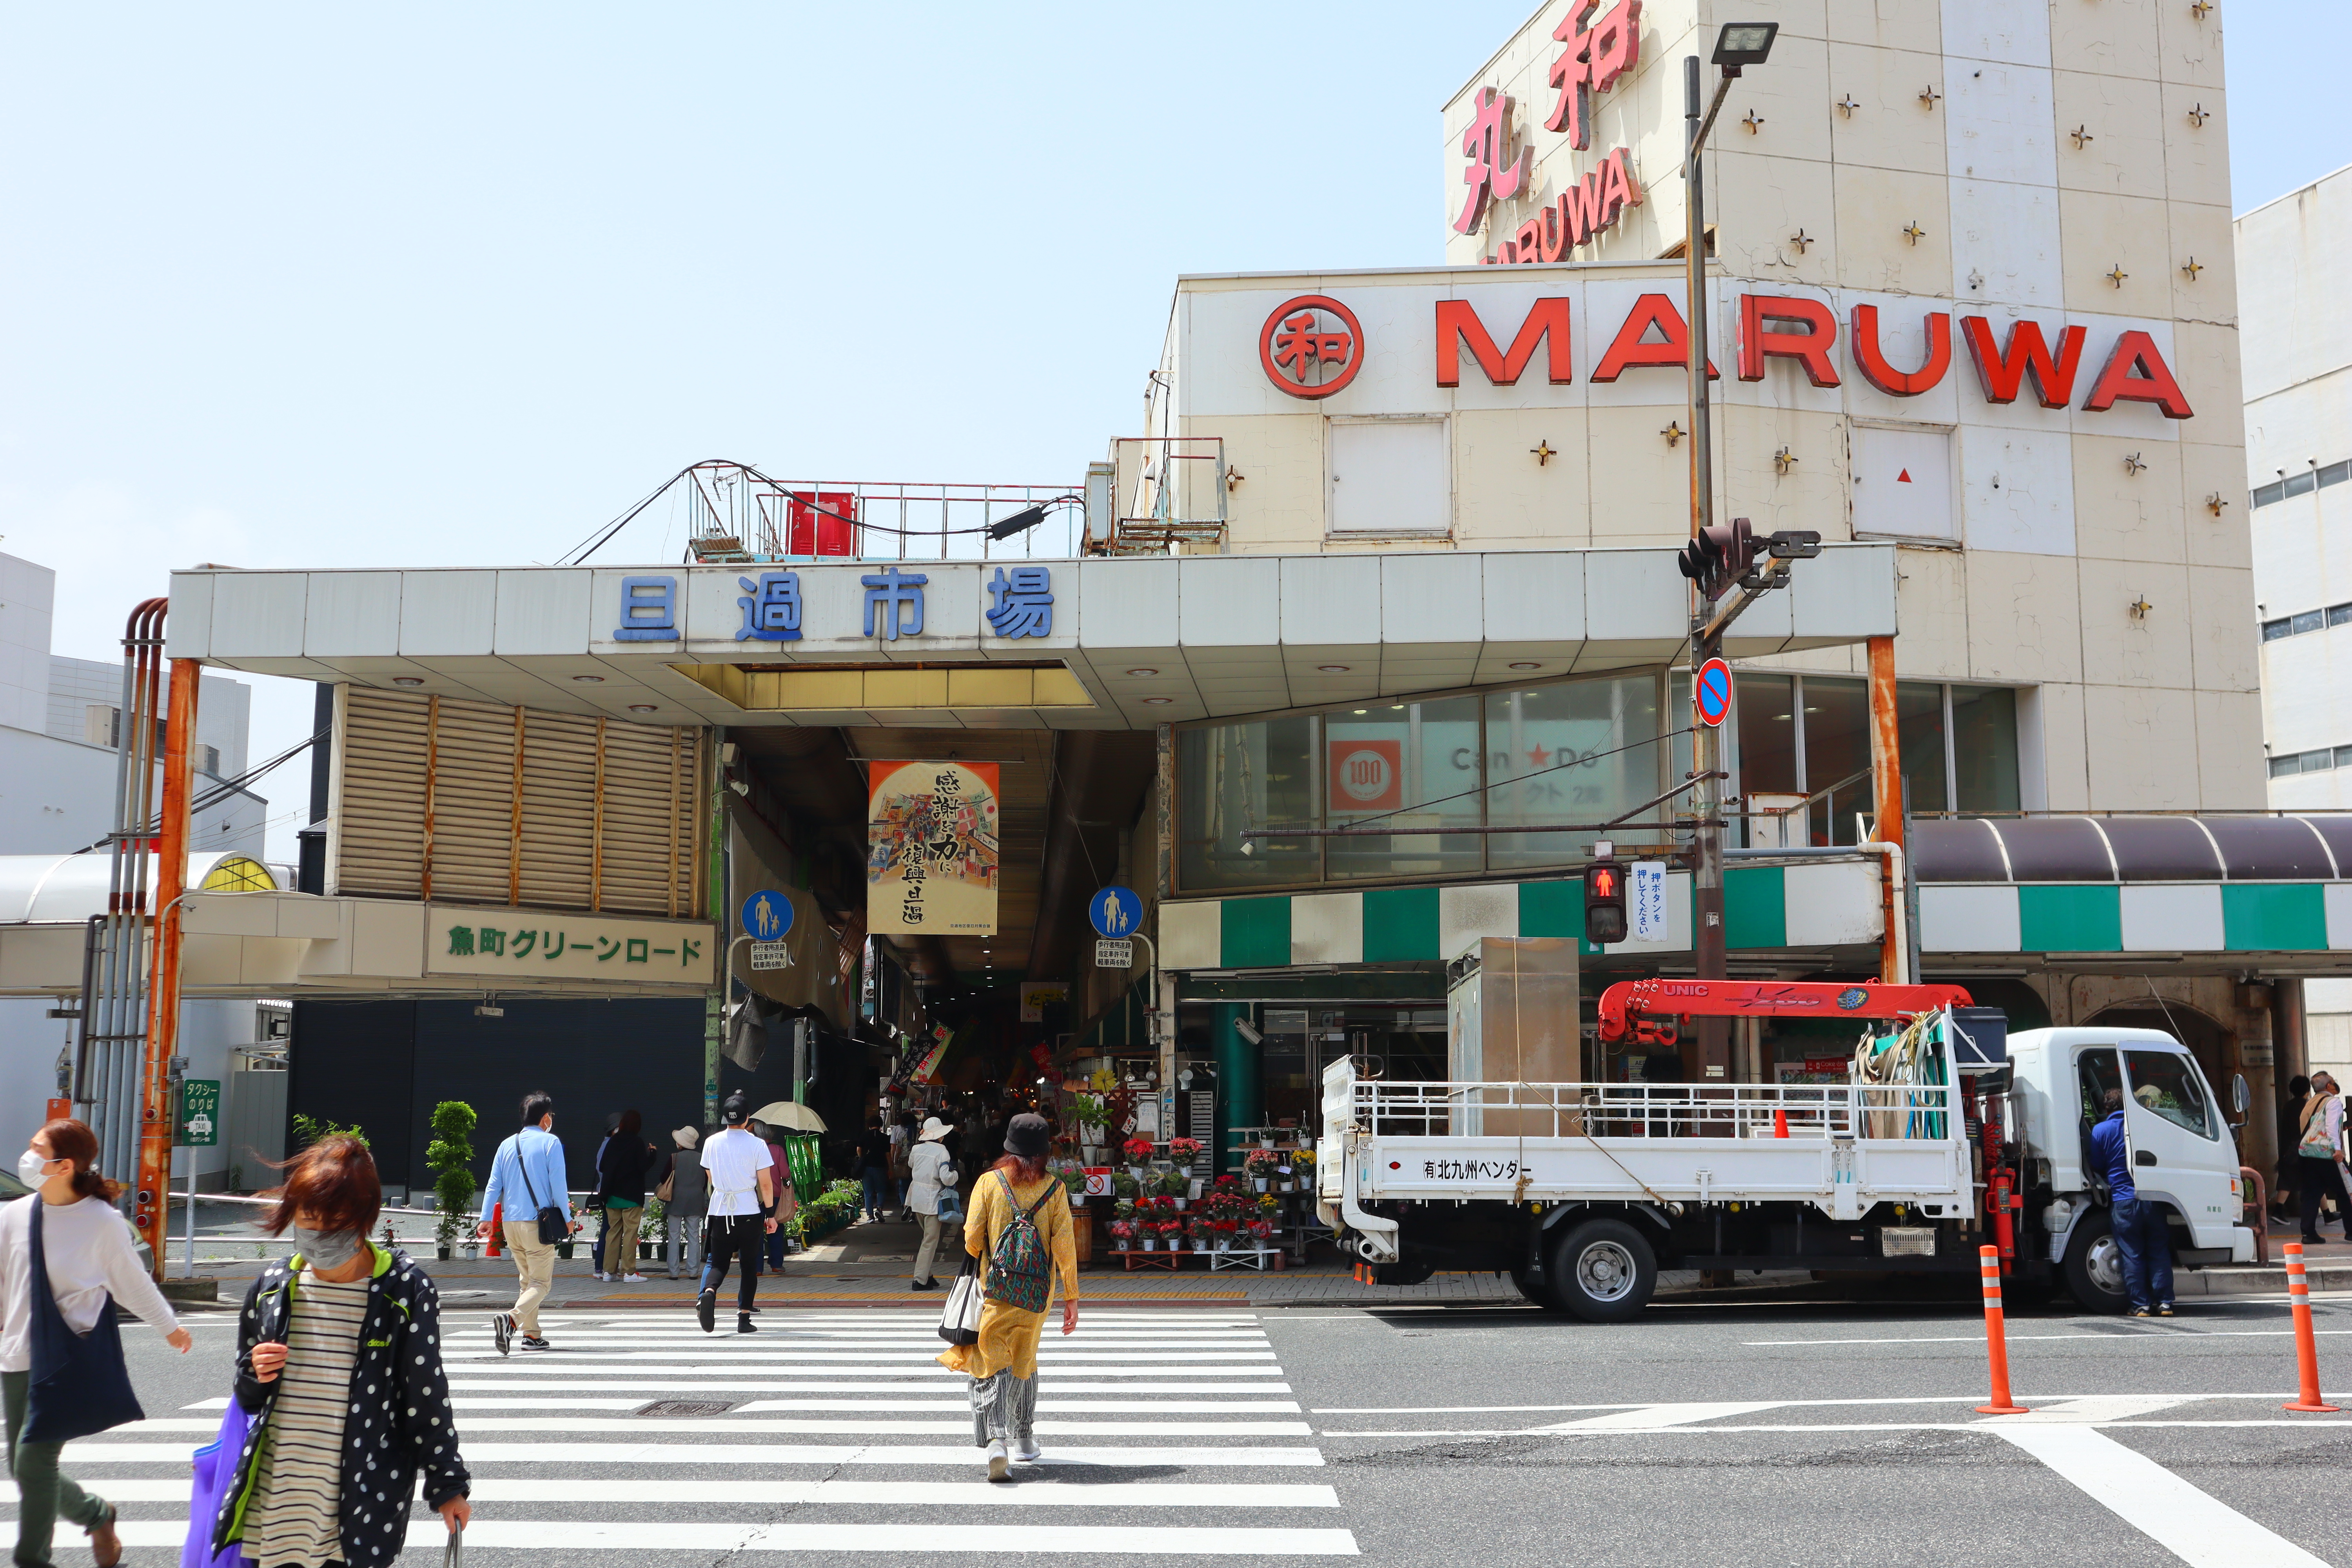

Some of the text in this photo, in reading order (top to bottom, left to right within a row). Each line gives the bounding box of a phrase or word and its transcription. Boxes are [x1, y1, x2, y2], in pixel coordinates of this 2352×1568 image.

[1479, 147, 1643, 264] ARUWA
[1274, 312, 1352, 383] 和
[1436, 294, 2194, 419] MARUWA
[613, 566, 1054, 641] 旦過市場
[929, 771, 961, 873] 感謝を力に
[902, 844, 926, 925] 復興旦過
[1637, 869, 1648, 934] 押してください
[1651, 873, 1661, 922] 押ボタンを
[447, 926, 701, 967] 魚町グリーンロード
[1098, 941, 1131, 949] 歩行者用道路
[1663, 985, 1708, 996] UNIC
[187, 1083, 217, 1096] タクシー
[189, 1098, 214, 1111] のりば
